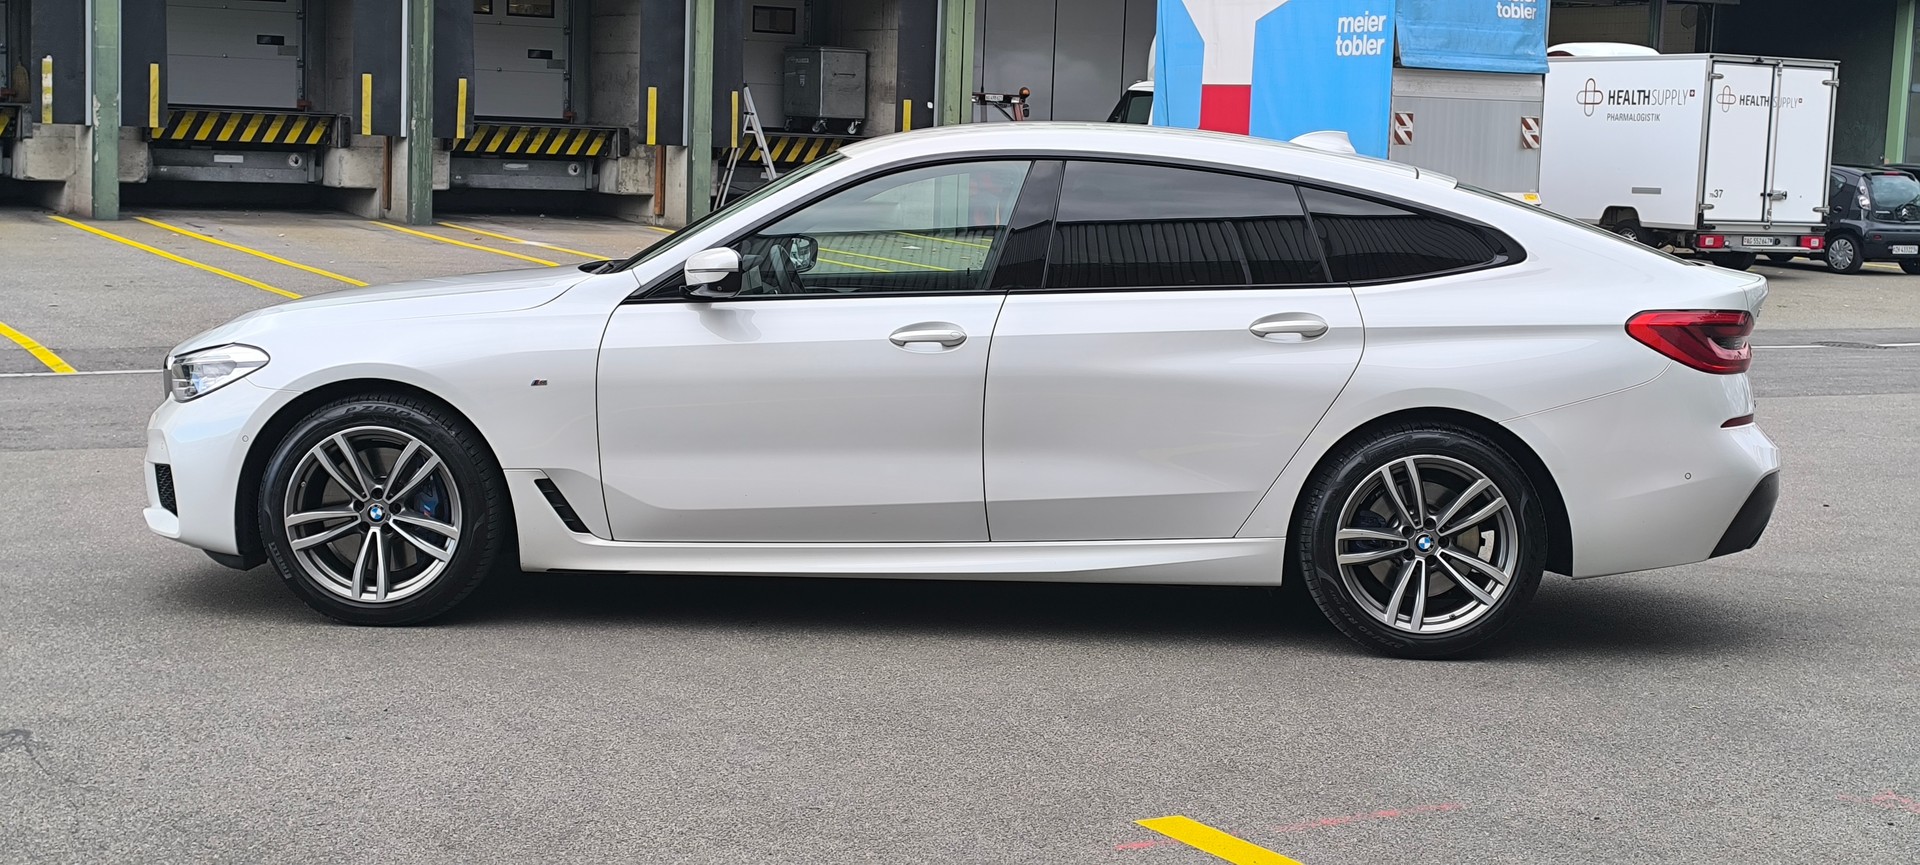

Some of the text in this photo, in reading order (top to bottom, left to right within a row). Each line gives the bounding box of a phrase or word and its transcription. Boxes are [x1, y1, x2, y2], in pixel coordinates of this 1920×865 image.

[1496, 2, 1538, 20] tobler
[1337, 11, 1387, 34] meier
[1336, 34, 1386, 57] tobler
[1606, 112, 1661, 122] PHARMALOGISTIK
